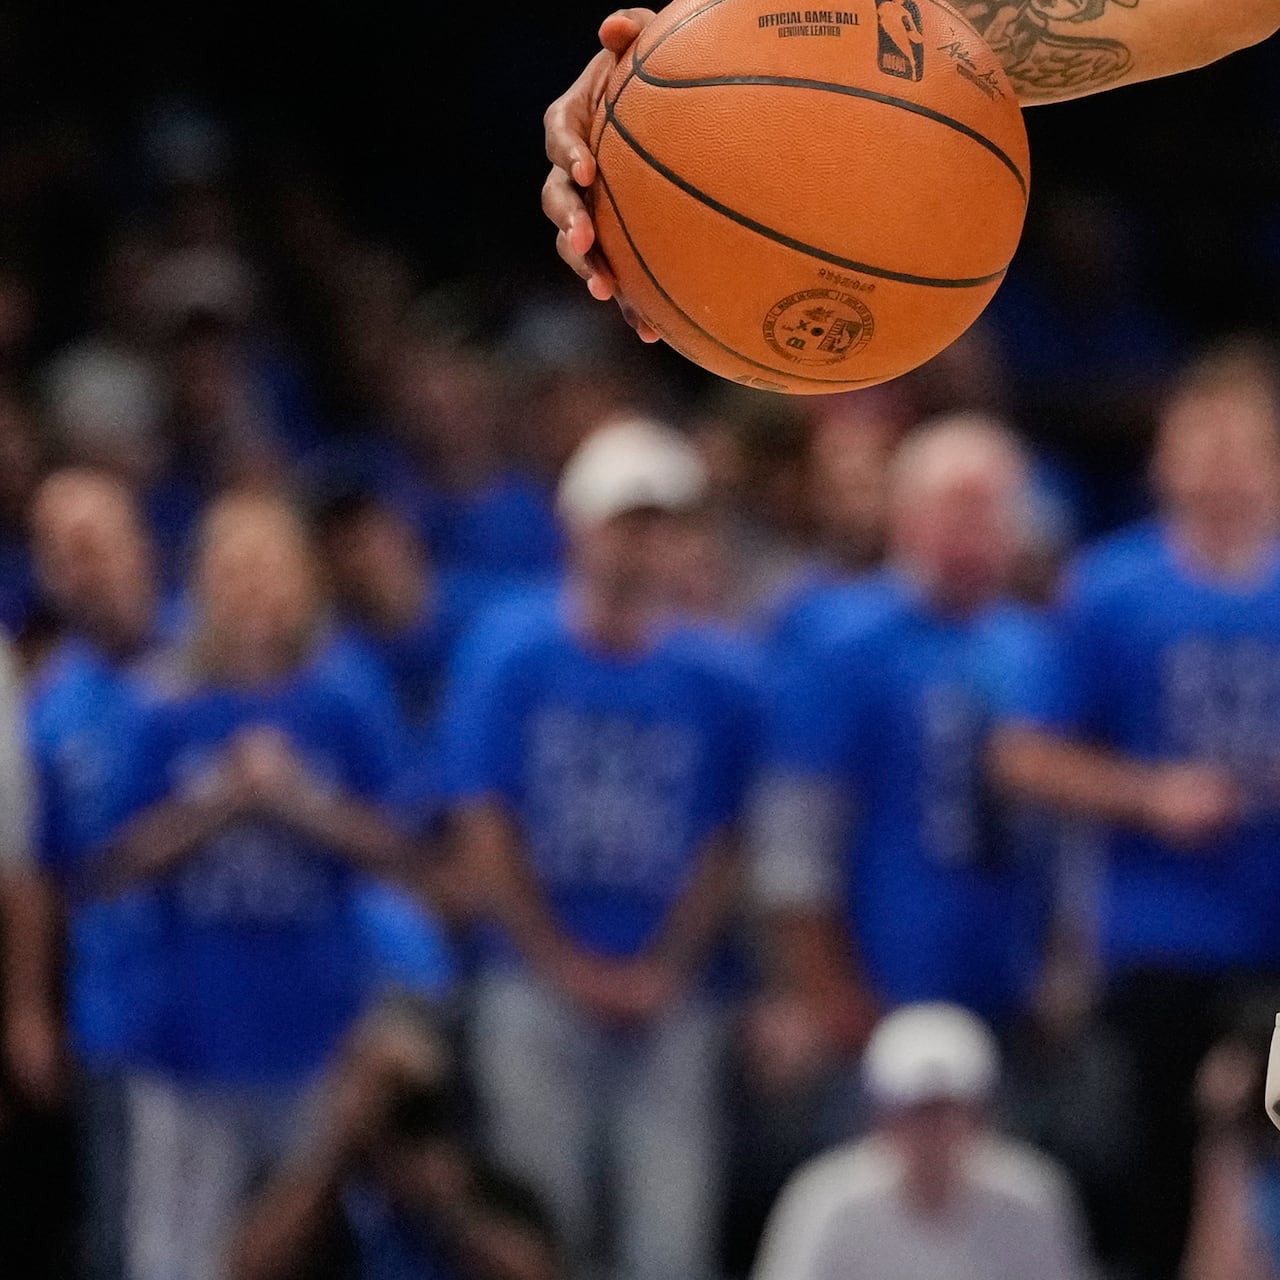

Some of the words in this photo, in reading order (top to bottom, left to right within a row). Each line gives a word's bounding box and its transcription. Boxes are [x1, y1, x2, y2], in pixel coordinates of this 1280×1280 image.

[758, 11, 802, 28] OFFICIAL
[804, 10, 834, 24] GAME
[835, 11, 860, 26] BALL
[777, 26, 809, 38] GENUINE
[810, 25, 841, 37] LEATHER
